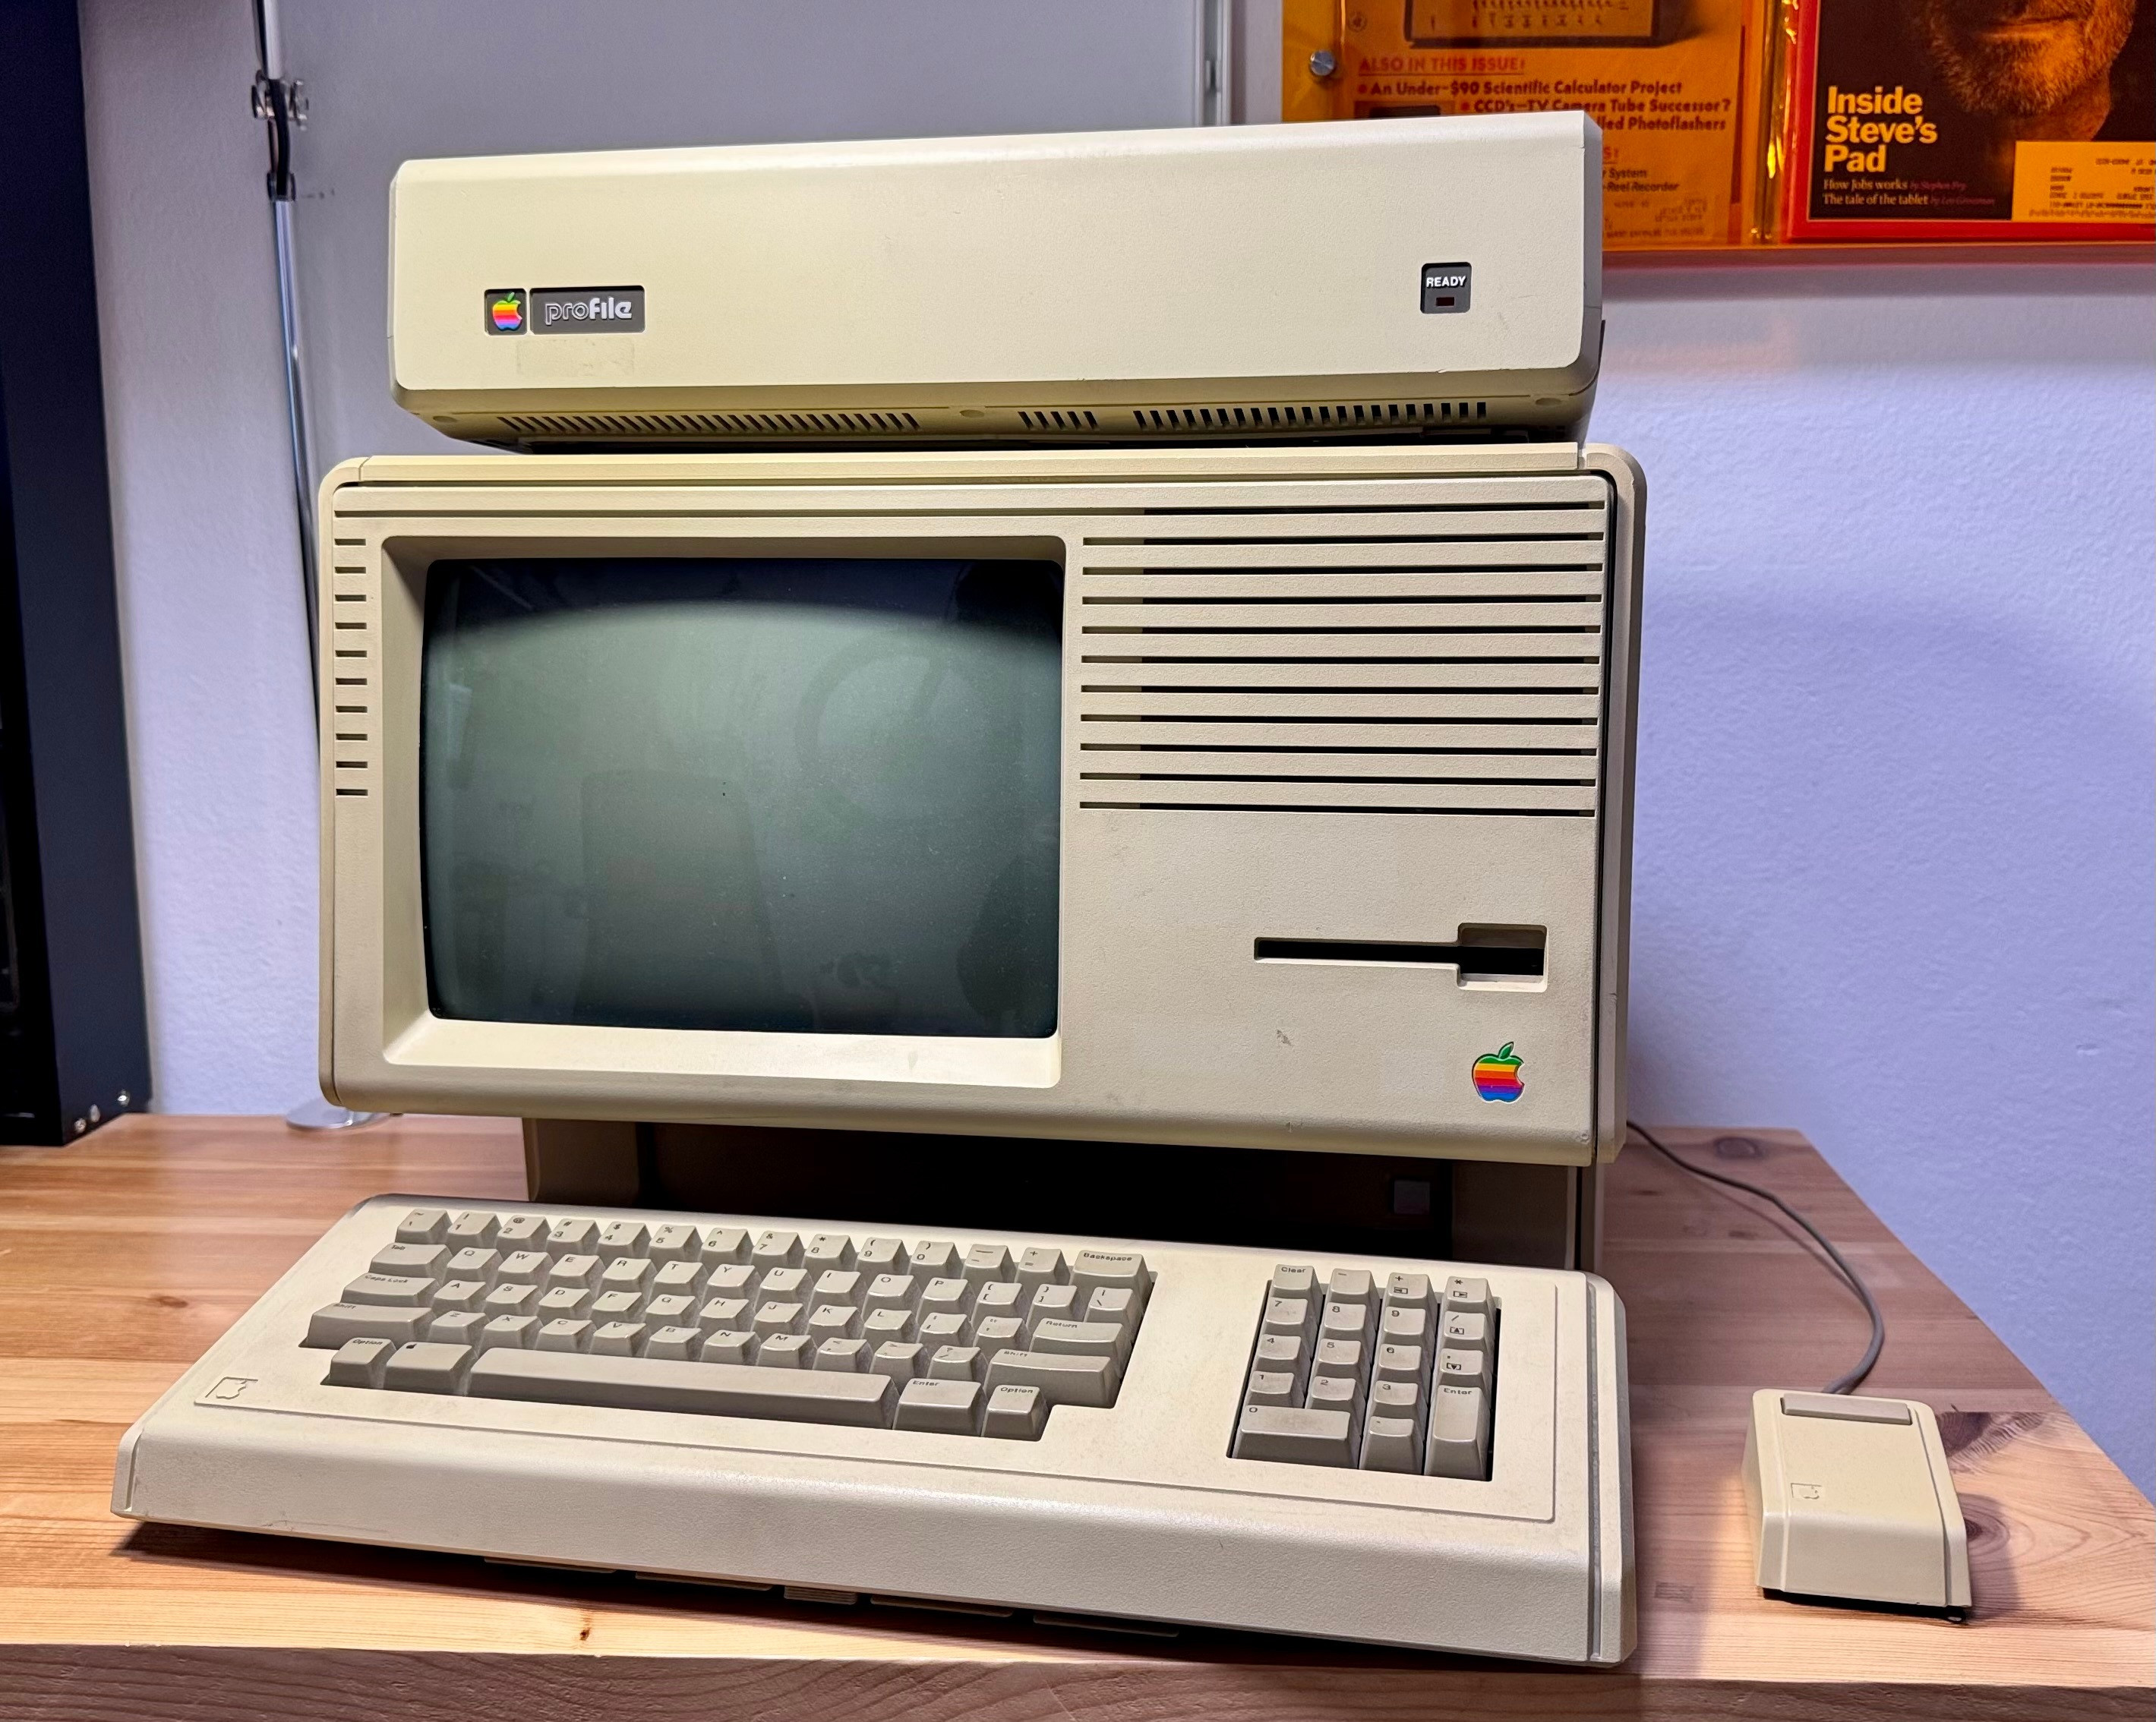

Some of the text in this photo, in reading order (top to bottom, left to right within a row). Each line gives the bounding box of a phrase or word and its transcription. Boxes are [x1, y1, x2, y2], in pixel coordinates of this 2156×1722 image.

[1359, 56, 1525, 71] ALSO IN THIS ISSUE!
[1370, 82, 1391, 95] An
[1484, 80, 1549, 94] Scientific
[1555, 80, 1627, 93] Calculator
[1631, 80, 1682, 96] Project
[1611, 99, 1645, 112] Tube
[1827, 86, 1923, 115] Inside
[1597, 116, 1725, 130] lled Photoflashers
[1825, 115, 1938, 144] Steve's
[1824, 144, 1887, 173] Pad
[1608, 168, 1647, 180] System
[1823, 178, 1849, 190] How
[1851, 178, 1873, 192] Jobs
[1875, 178, 1908, 190] works
[1824, 193, 1843, 205] The
[1845, 194, 1864, 204] tale
[1866, 193, 1877, 204] of
[1879, 194, 1896, 204] the
[1899, 194, 1929, 205] tablet
[1426, 276, 1466, 288] READY
[1084, 1252, 1132, 1261] Backspace
